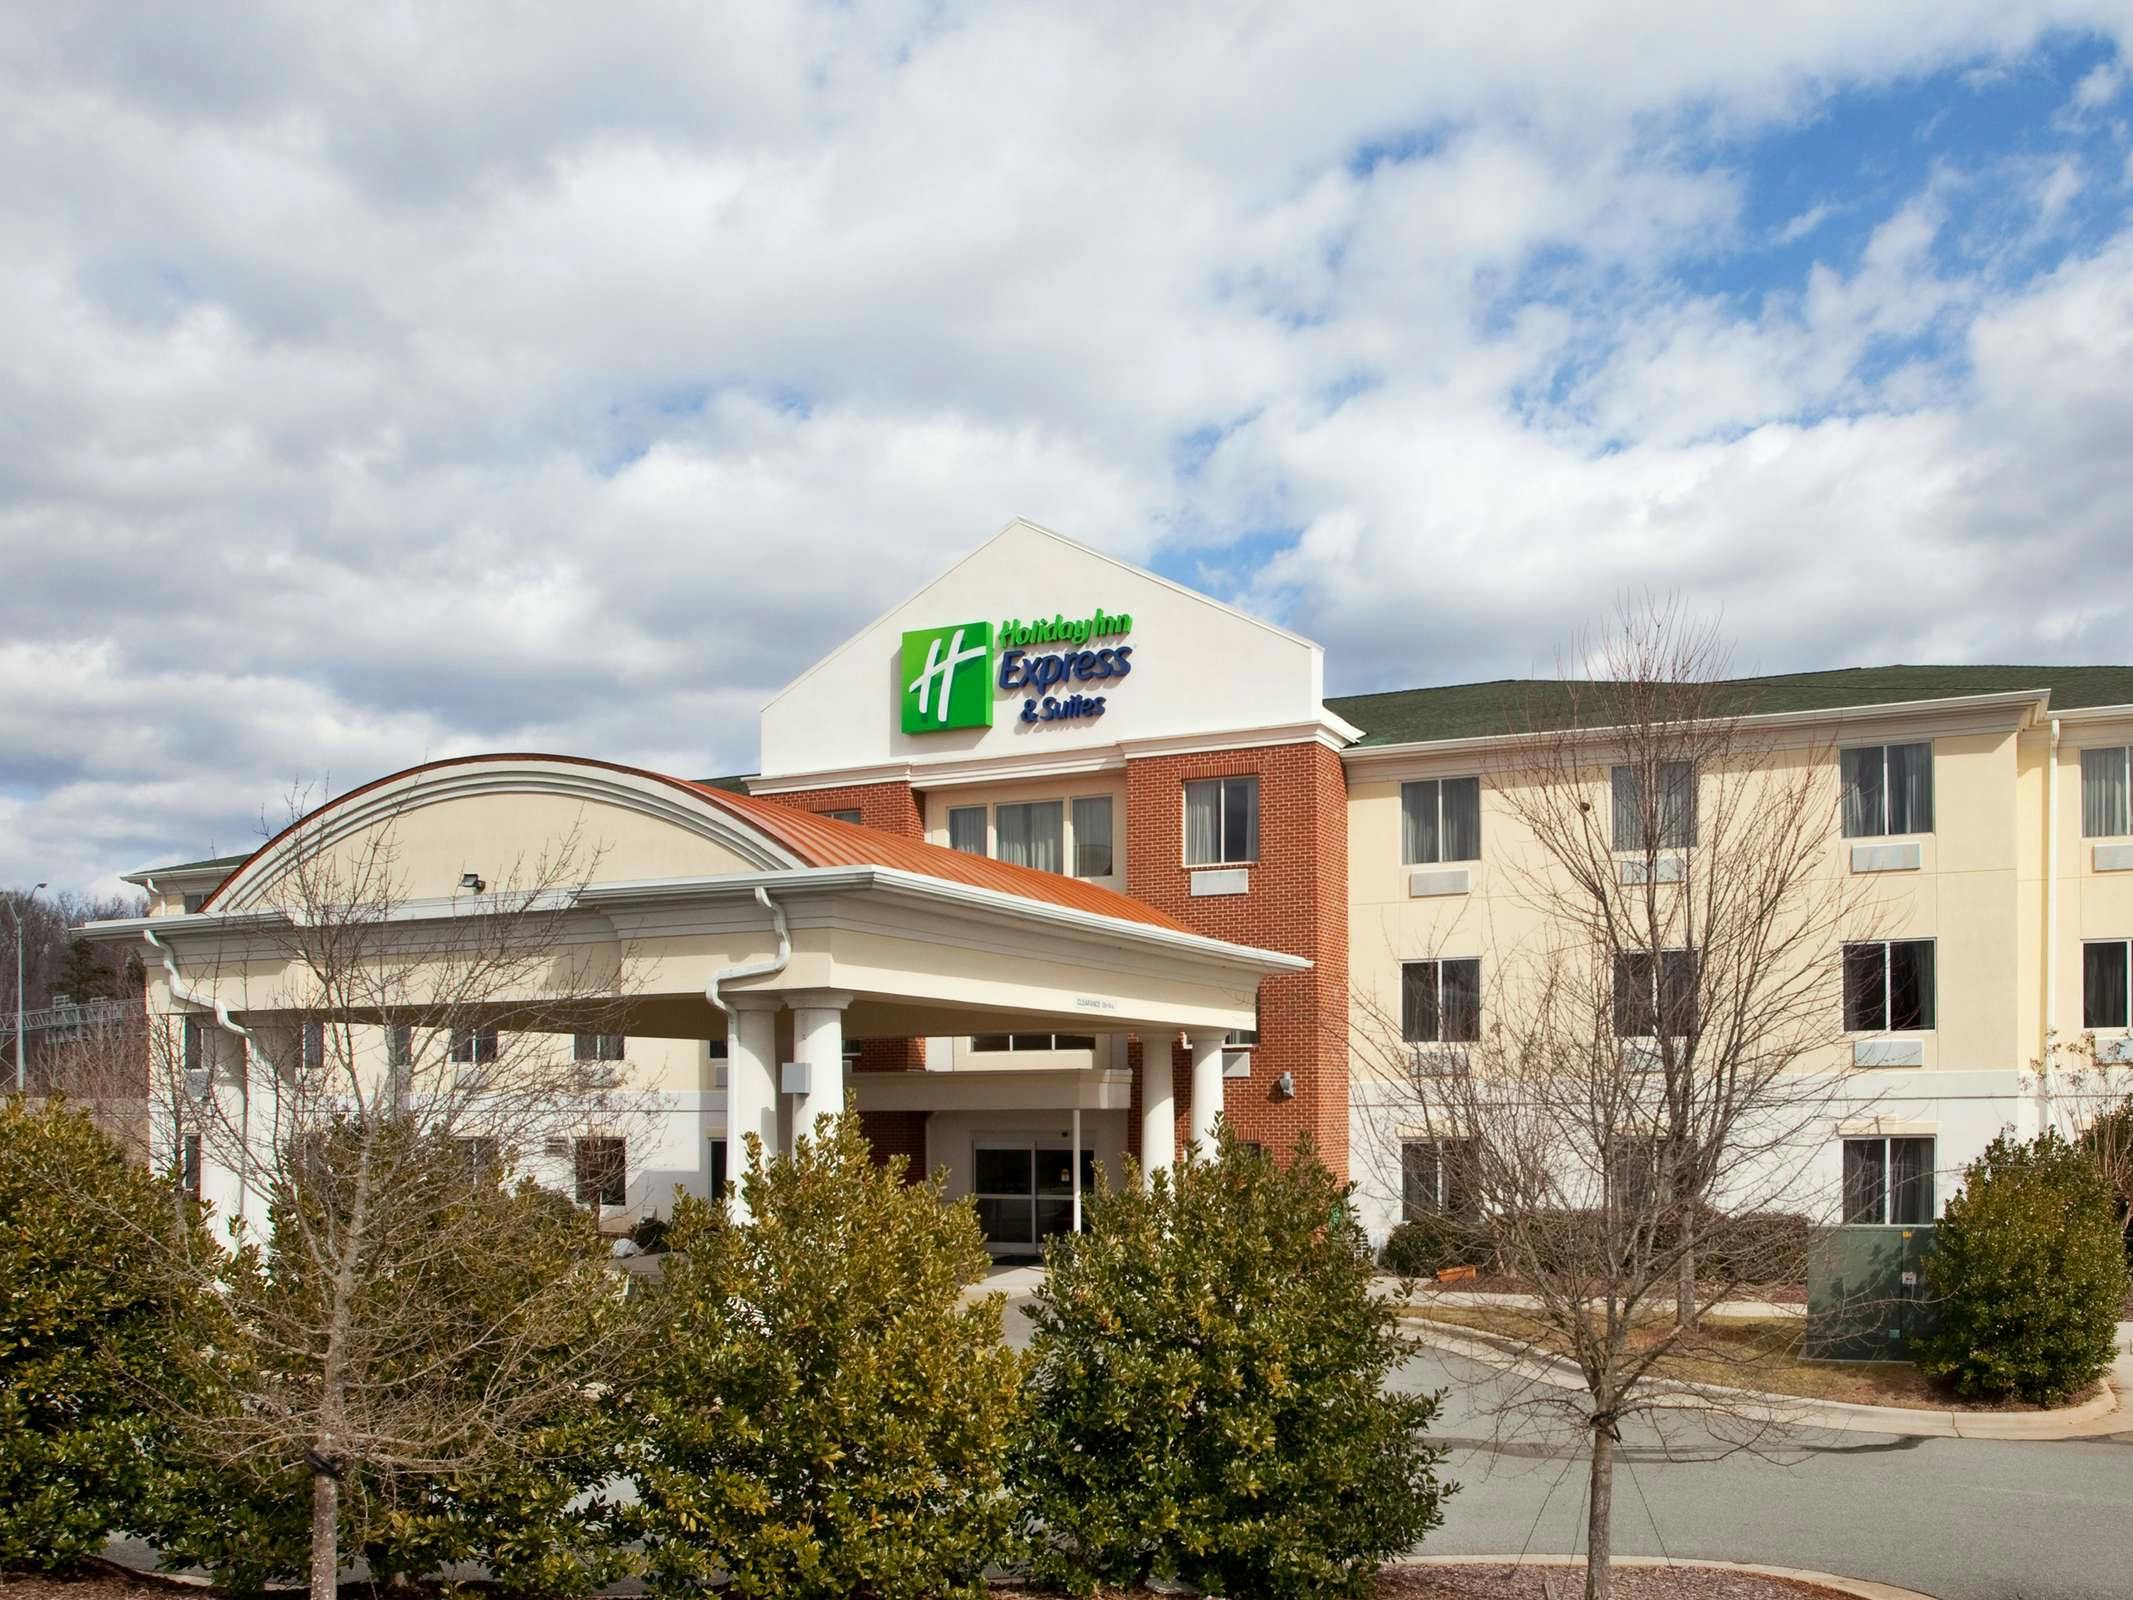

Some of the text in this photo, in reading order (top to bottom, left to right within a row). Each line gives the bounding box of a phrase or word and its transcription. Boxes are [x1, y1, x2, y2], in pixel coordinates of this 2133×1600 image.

[999, 608, 1133, 648] Holiday Inn
[999, 646, 1133, 696] Express
[1020, 694, 1107, 723] & Suites
